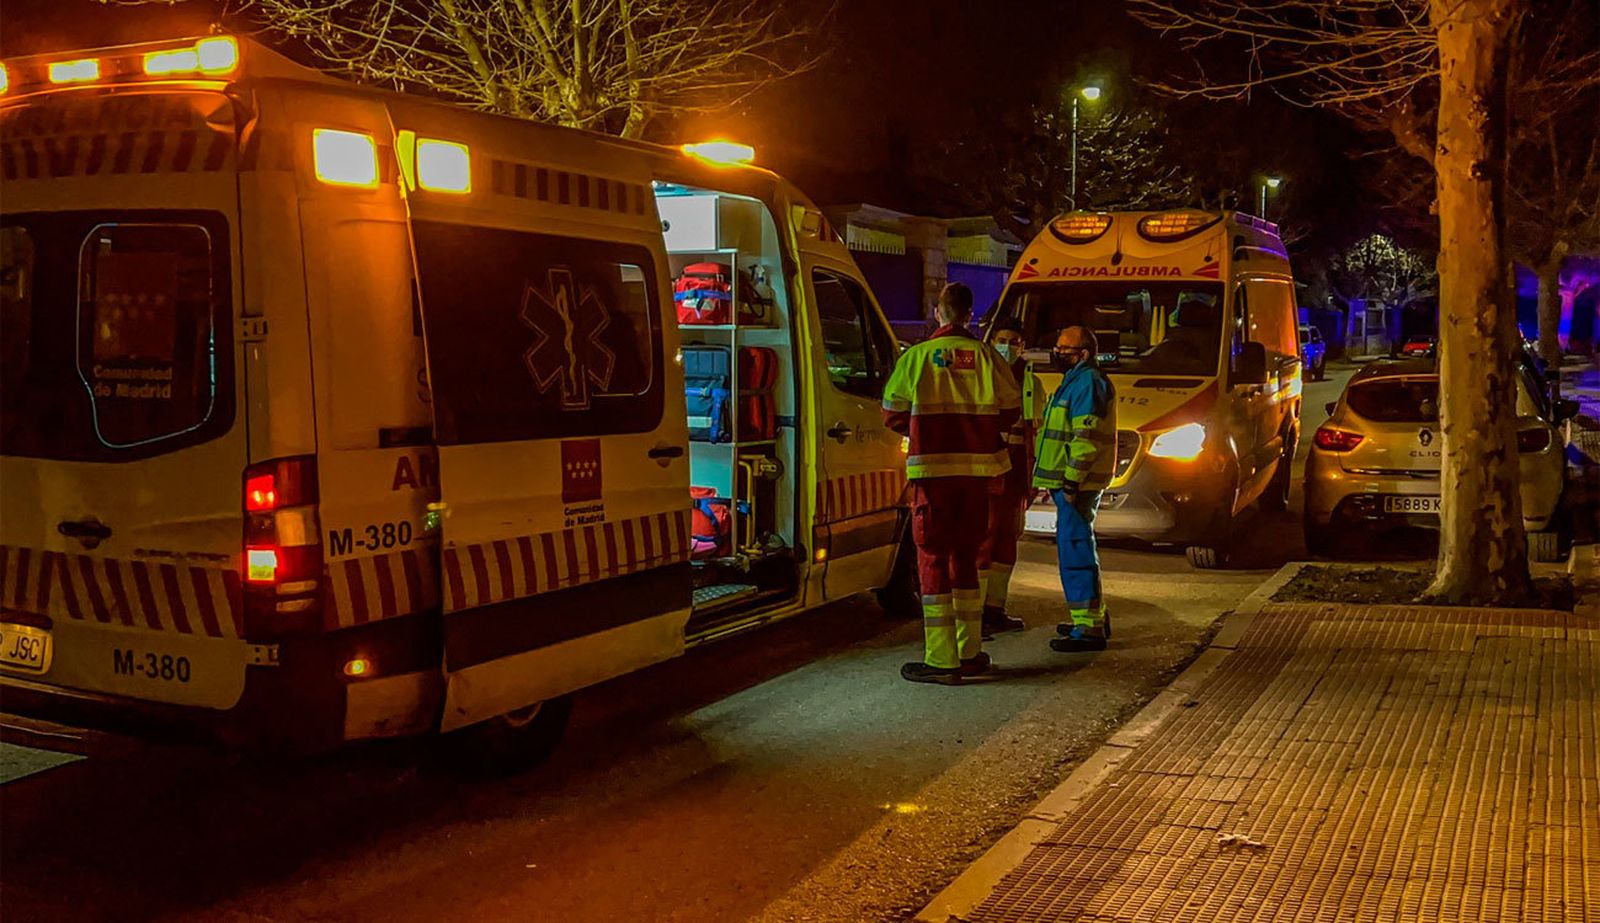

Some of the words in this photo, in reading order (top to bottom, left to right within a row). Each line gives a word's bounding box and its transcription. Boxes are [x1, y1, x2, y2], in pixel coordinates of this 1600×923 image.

[93, 364, 173, 380] Comunidad
[94, 383, 111, 397] de
[116, 383, 172, 399] Madrid
[1395, 498, 1430, 511] 5889
[329, 520, 413, 557] M-380
[9, 635, 41, 662] JSC
[113, 648, 192, 684] M-380
